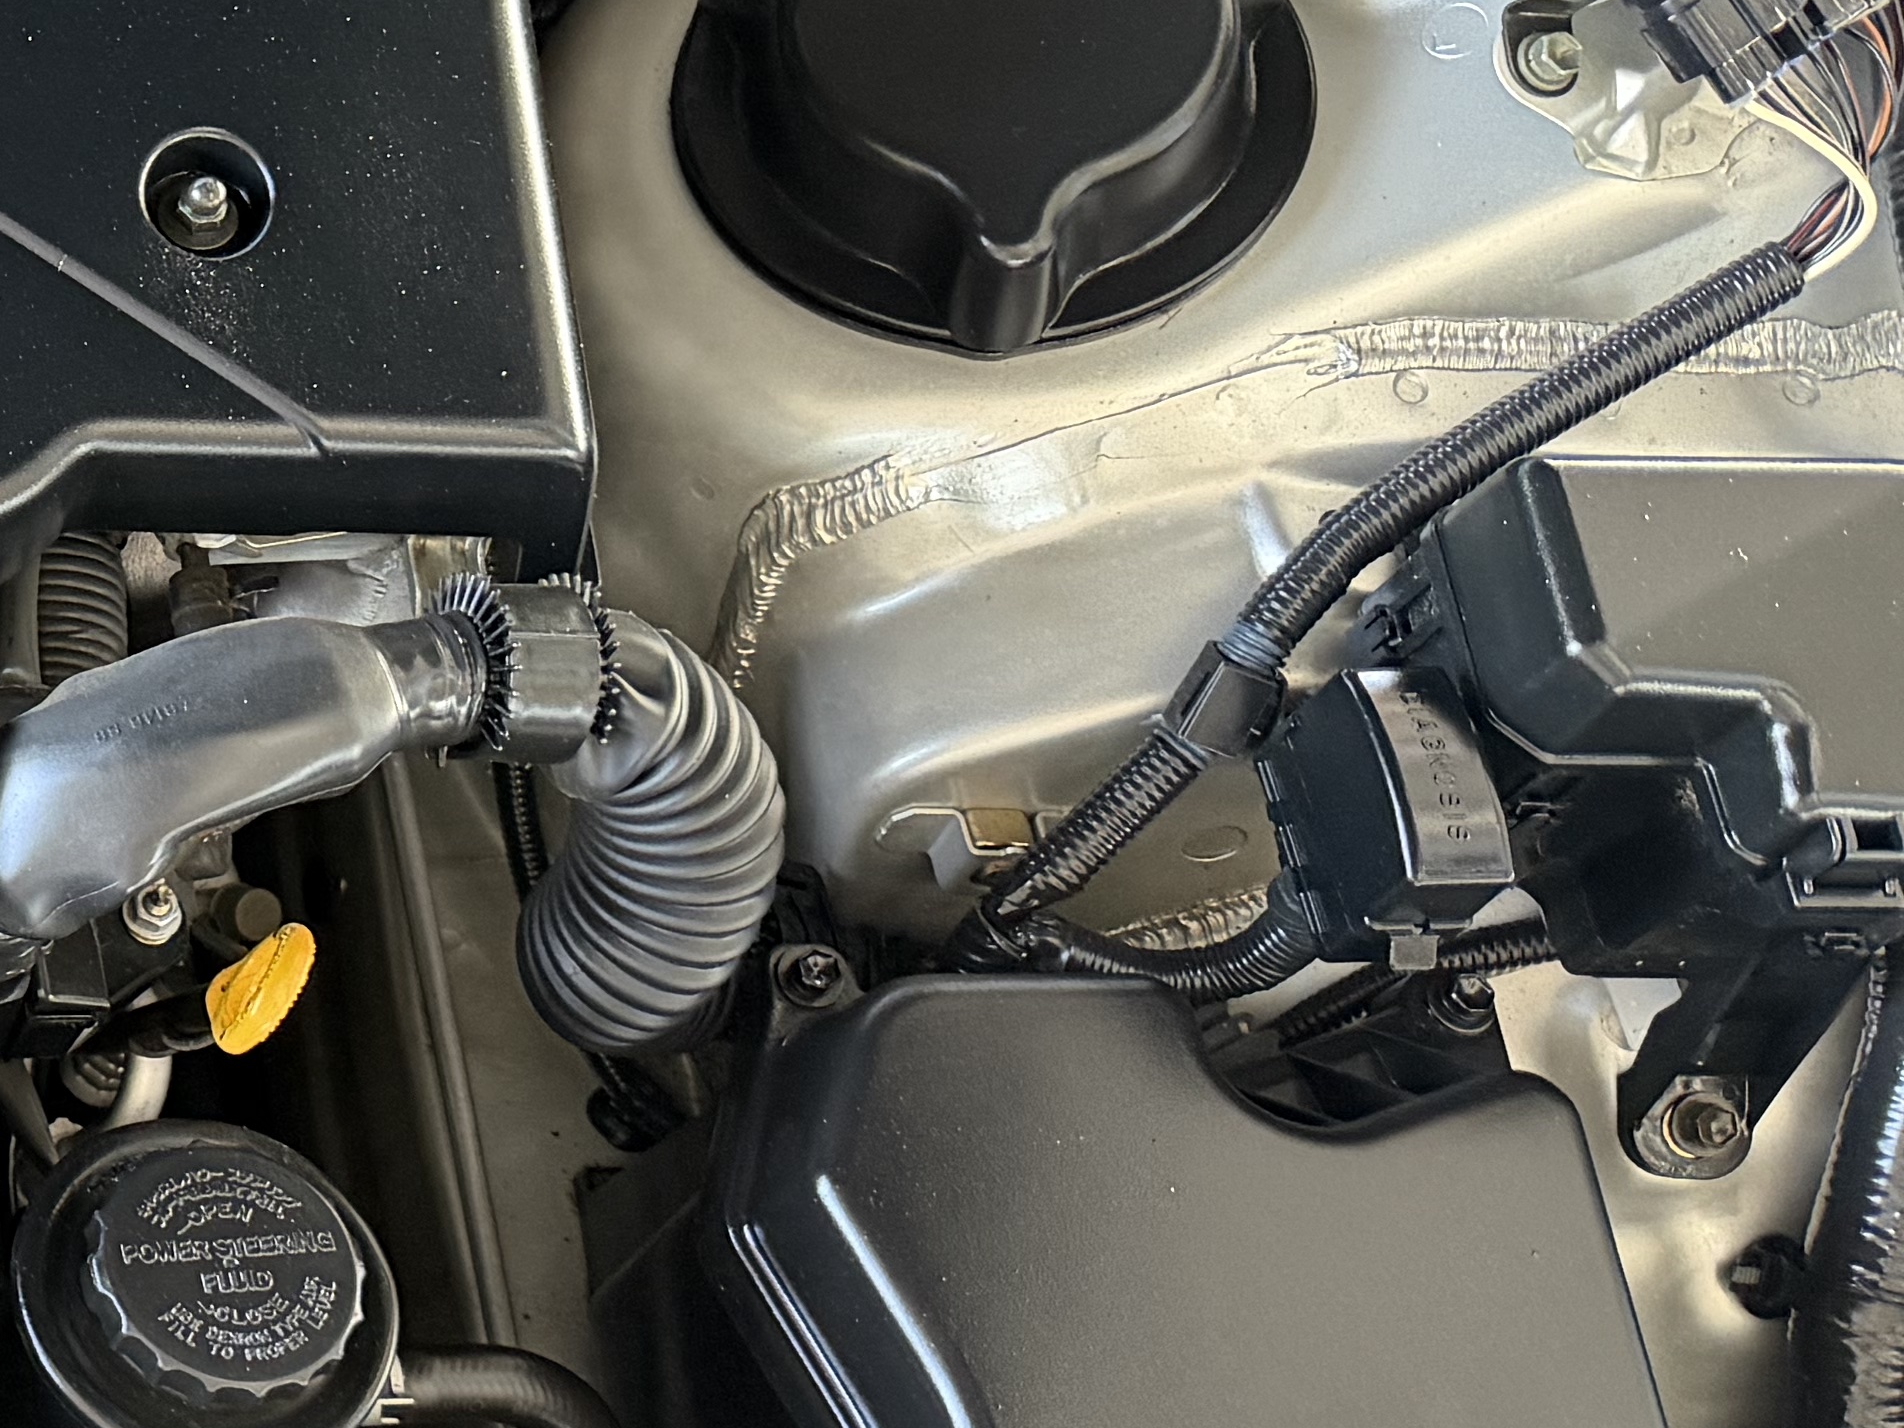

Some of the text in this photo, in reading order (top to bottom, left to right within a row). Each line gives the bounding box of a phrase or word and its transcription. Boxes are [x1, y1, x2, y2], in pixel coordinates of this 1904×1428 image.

[1399, 691, 1473, 846] DIAGNOSIS
[187, 1201, 254, 1226] OPEN
[119, 1231, 337, 1264] POWER STEERING
[200, 1269, 275, 1294] FLUID
[158, 1311, 196, 1347] FILL
[209, 1342, 234, 1359] TO
[305, 1281, 337, 1330] LEVEL
[213, 1292, 290, 1325] CLOSE
